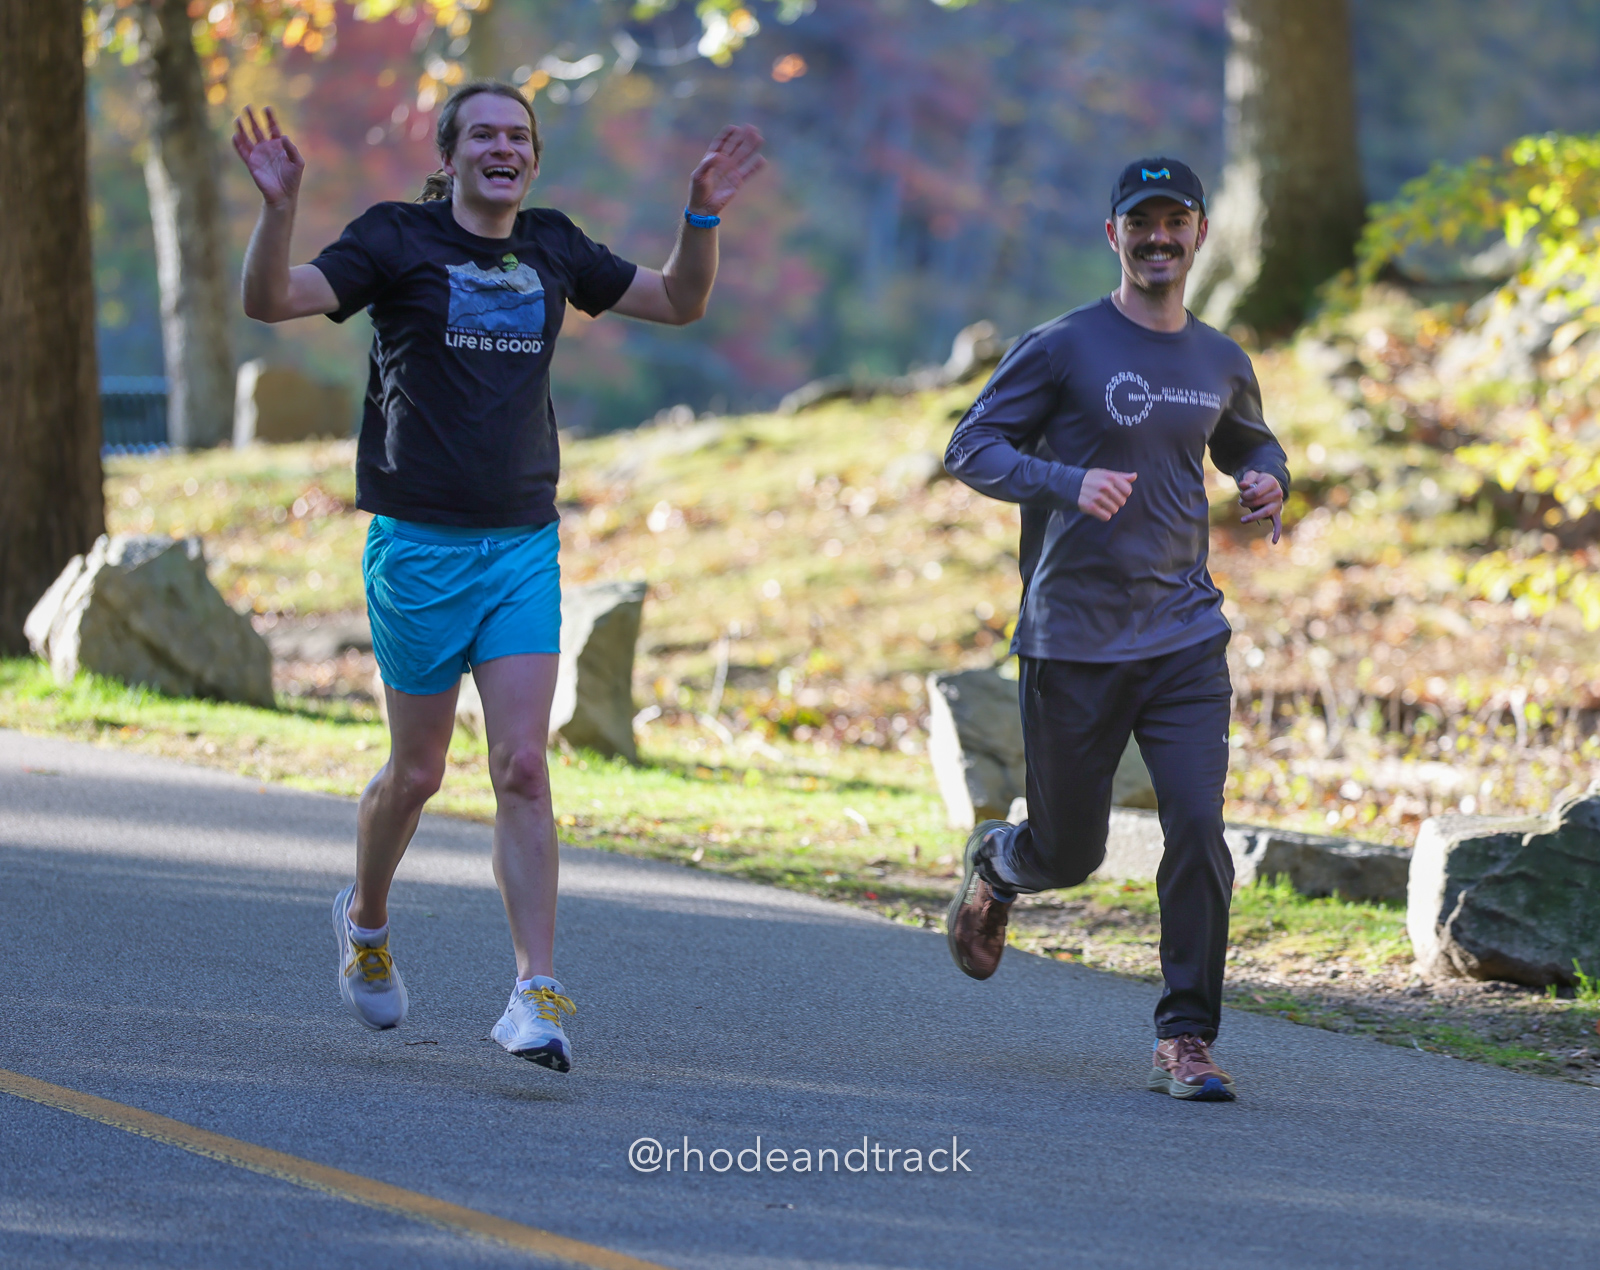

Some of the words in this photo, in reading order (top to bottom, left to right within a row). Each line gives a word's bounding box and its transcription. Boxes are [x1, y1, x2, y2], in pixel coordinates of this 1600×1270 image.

[480, 336, 493, 352] IS
[1128, 392, 1146, 402] Move
[1146, 392, 1163, 402] Your
[1189, 395, 1199, 405] for
